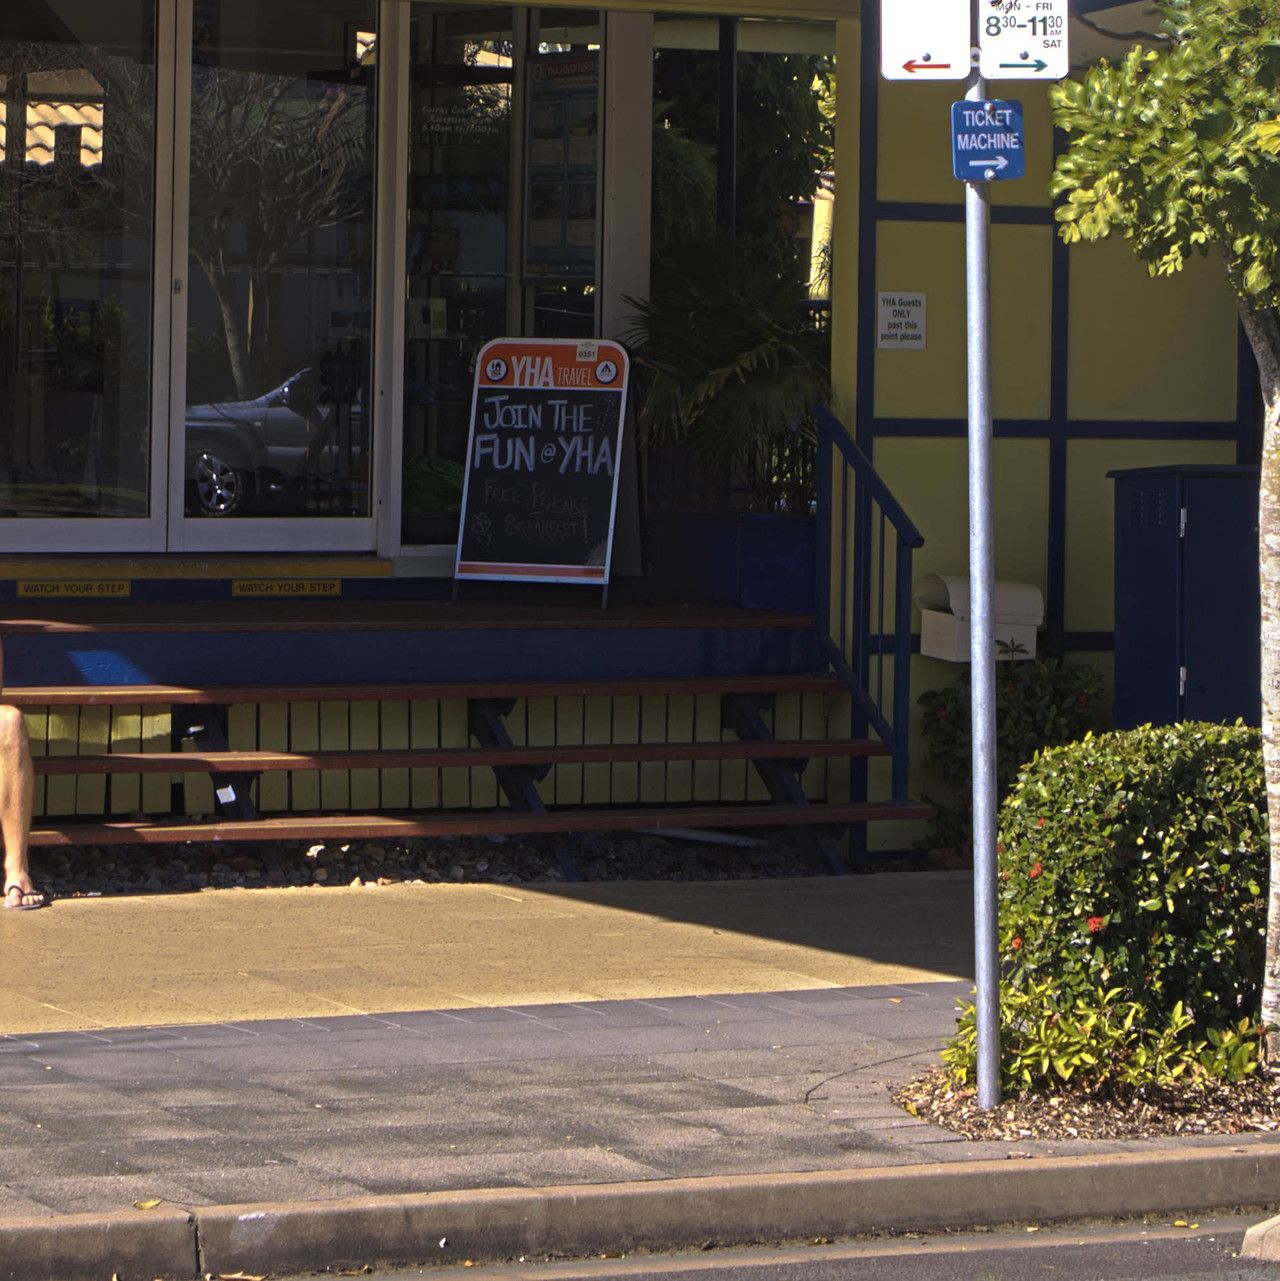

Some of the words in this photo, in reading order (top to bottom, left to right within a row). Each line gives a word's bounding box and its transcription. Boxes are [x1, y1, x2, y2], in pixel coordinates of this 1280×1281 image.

[1035, 2, 1053, 11] FRI
[1043, 40, 1063, 49] SAT
[963, 110, 1012, 127] TICKET
[957, 133, 1020, 150] MACHINE
[881, 298, 896, 307] YHA
[898, 298, 922, 307] Guests
[892, 309, 911, 318] ONLY
[904, 320, 918, 329] this
[880, 332, 898, 342] point
[900, 332, 922, 342] please
[511, 356, 554, 388] YHA
[556, 367, 593, 386] TRAVEL
[483, 394, 542, 430] JOIN
[547, 400, 593, 432] THE
[474, 433, 535, 472] FUN
[558, 435, 614, 477] YHA
[24, 583, 59, 593] WATCH
[64, 583, 93, 593] YOUR
[97, 583, 125, 593] STEP
[240, 583, 273, 593] WATCH
[277, 582, 305, 593] YOUR
[310, 582, 336, 592] STEP
